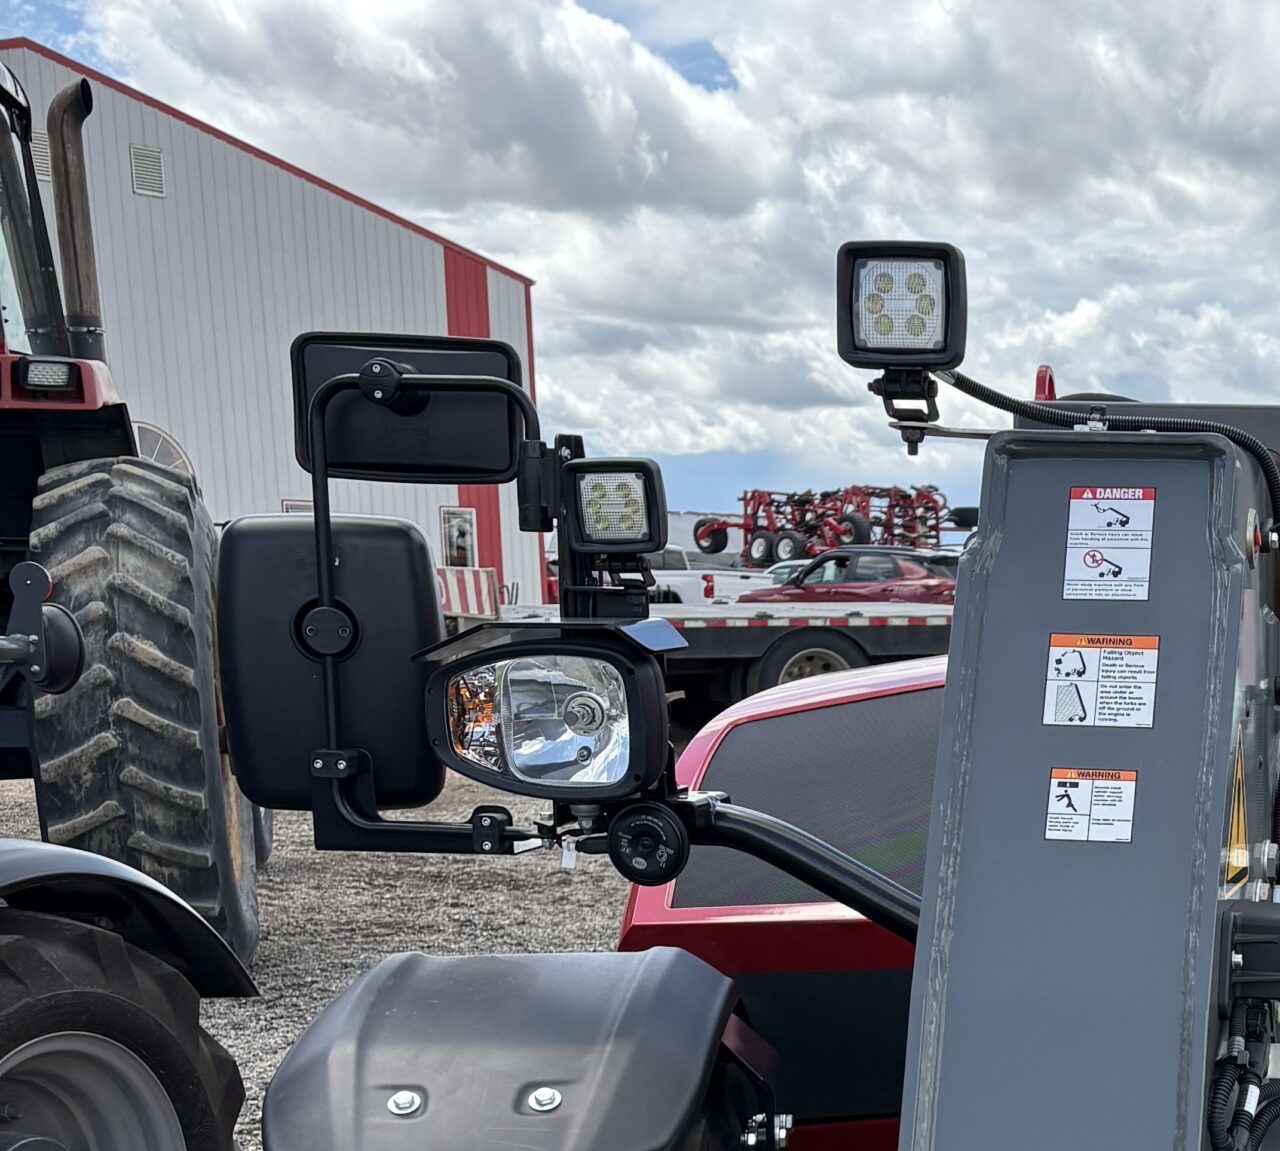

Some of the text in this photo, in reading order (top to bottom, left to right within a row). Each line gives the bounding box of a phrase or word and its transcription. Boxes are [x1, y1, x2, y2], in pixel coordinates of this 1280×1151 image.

[1096, 488, 1143, 499] DANGER
[1087, 638, 1133, 646] WARNING
[1077, 771, 1121, 779] WARNING
